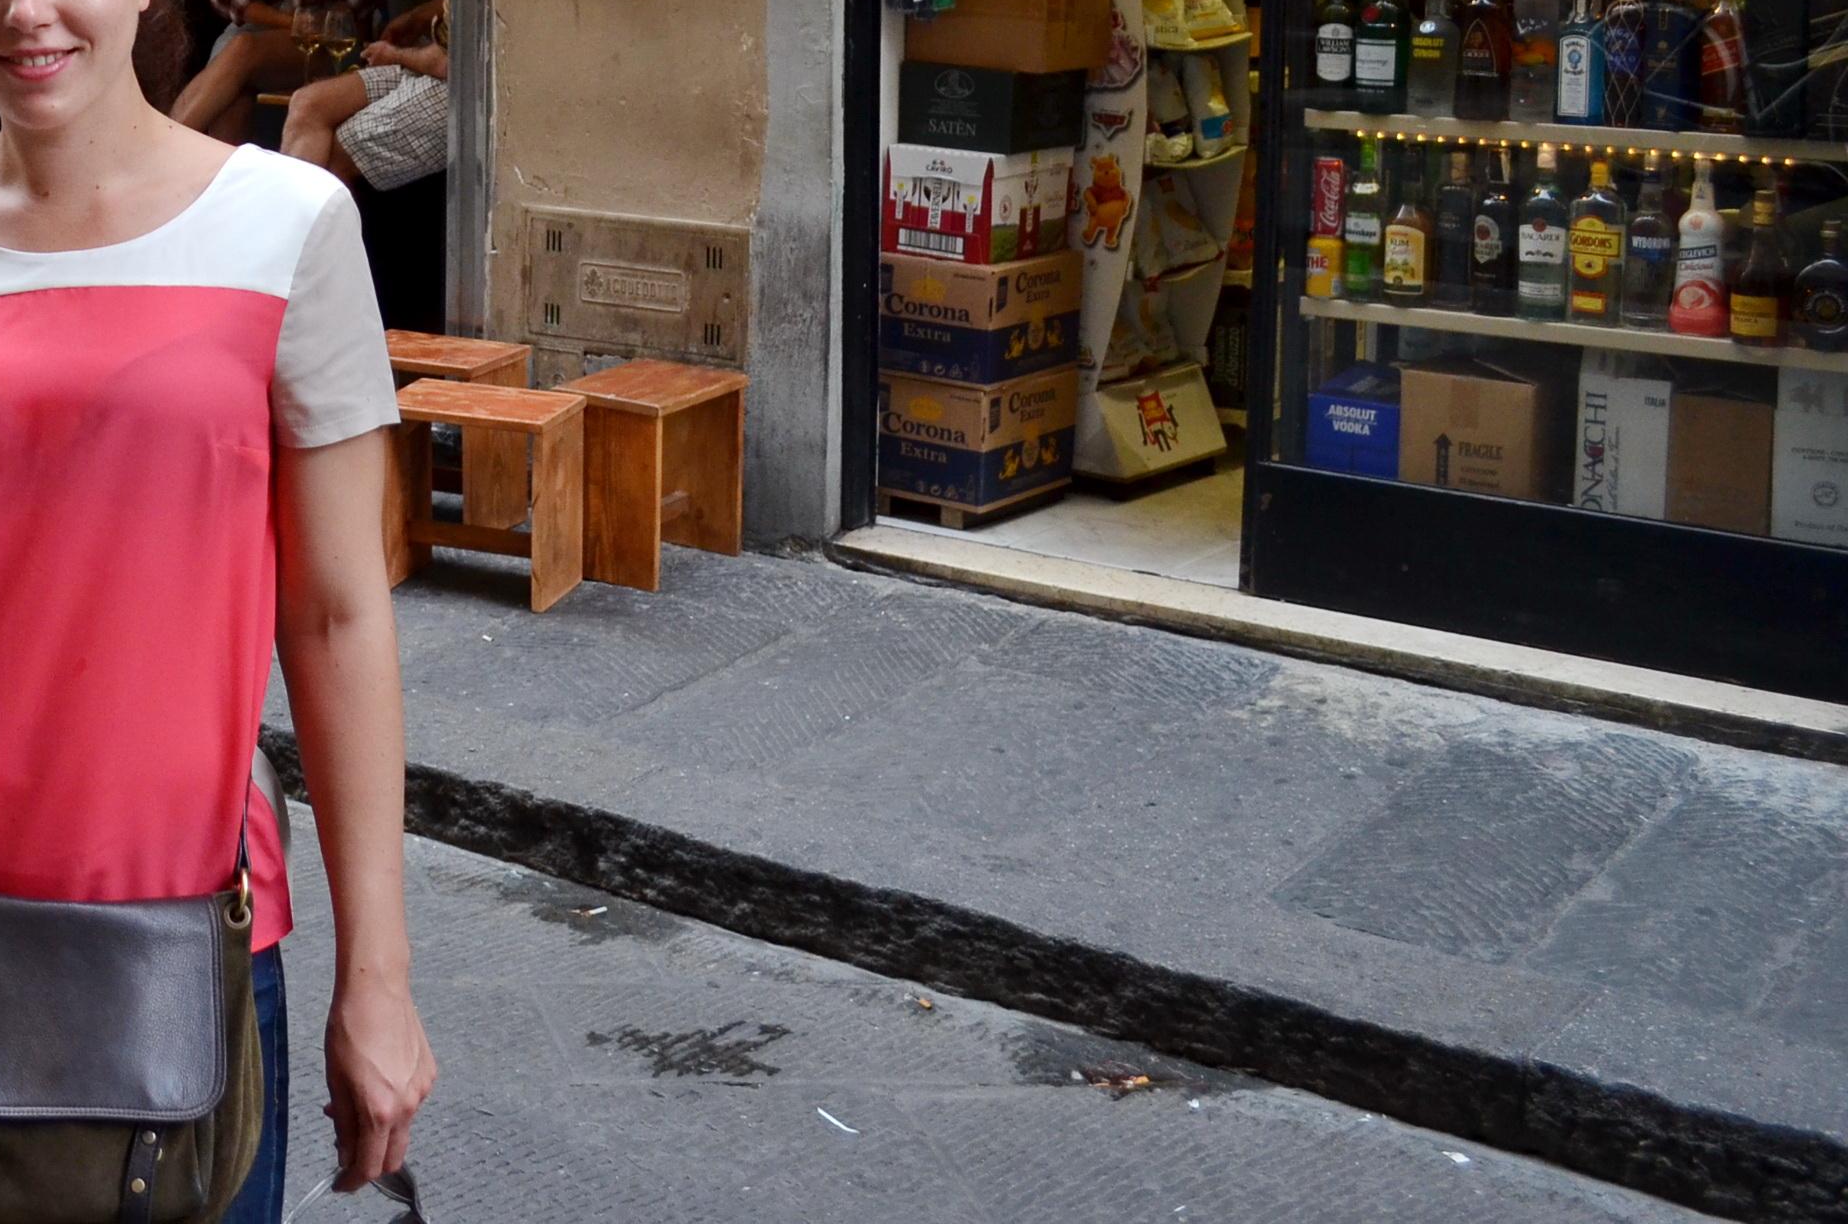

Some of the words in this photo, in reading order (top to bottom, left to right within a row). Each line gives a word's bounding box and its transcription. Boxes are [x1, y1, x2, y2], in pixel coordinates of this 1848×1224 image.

[1016, 269, 1061, 294] Corona
[885, 293, 971, 323] Corona
[903, 322, 952, 343] Extra
[1009, 387, 1058, 414] Corona
[1327, 404, 1377, 422] ABSOLUT
[882, 412, 967, 443] Corona
[1332, 419, 1371, 436] VODKA
[899, 442, 948, 464] Extra
